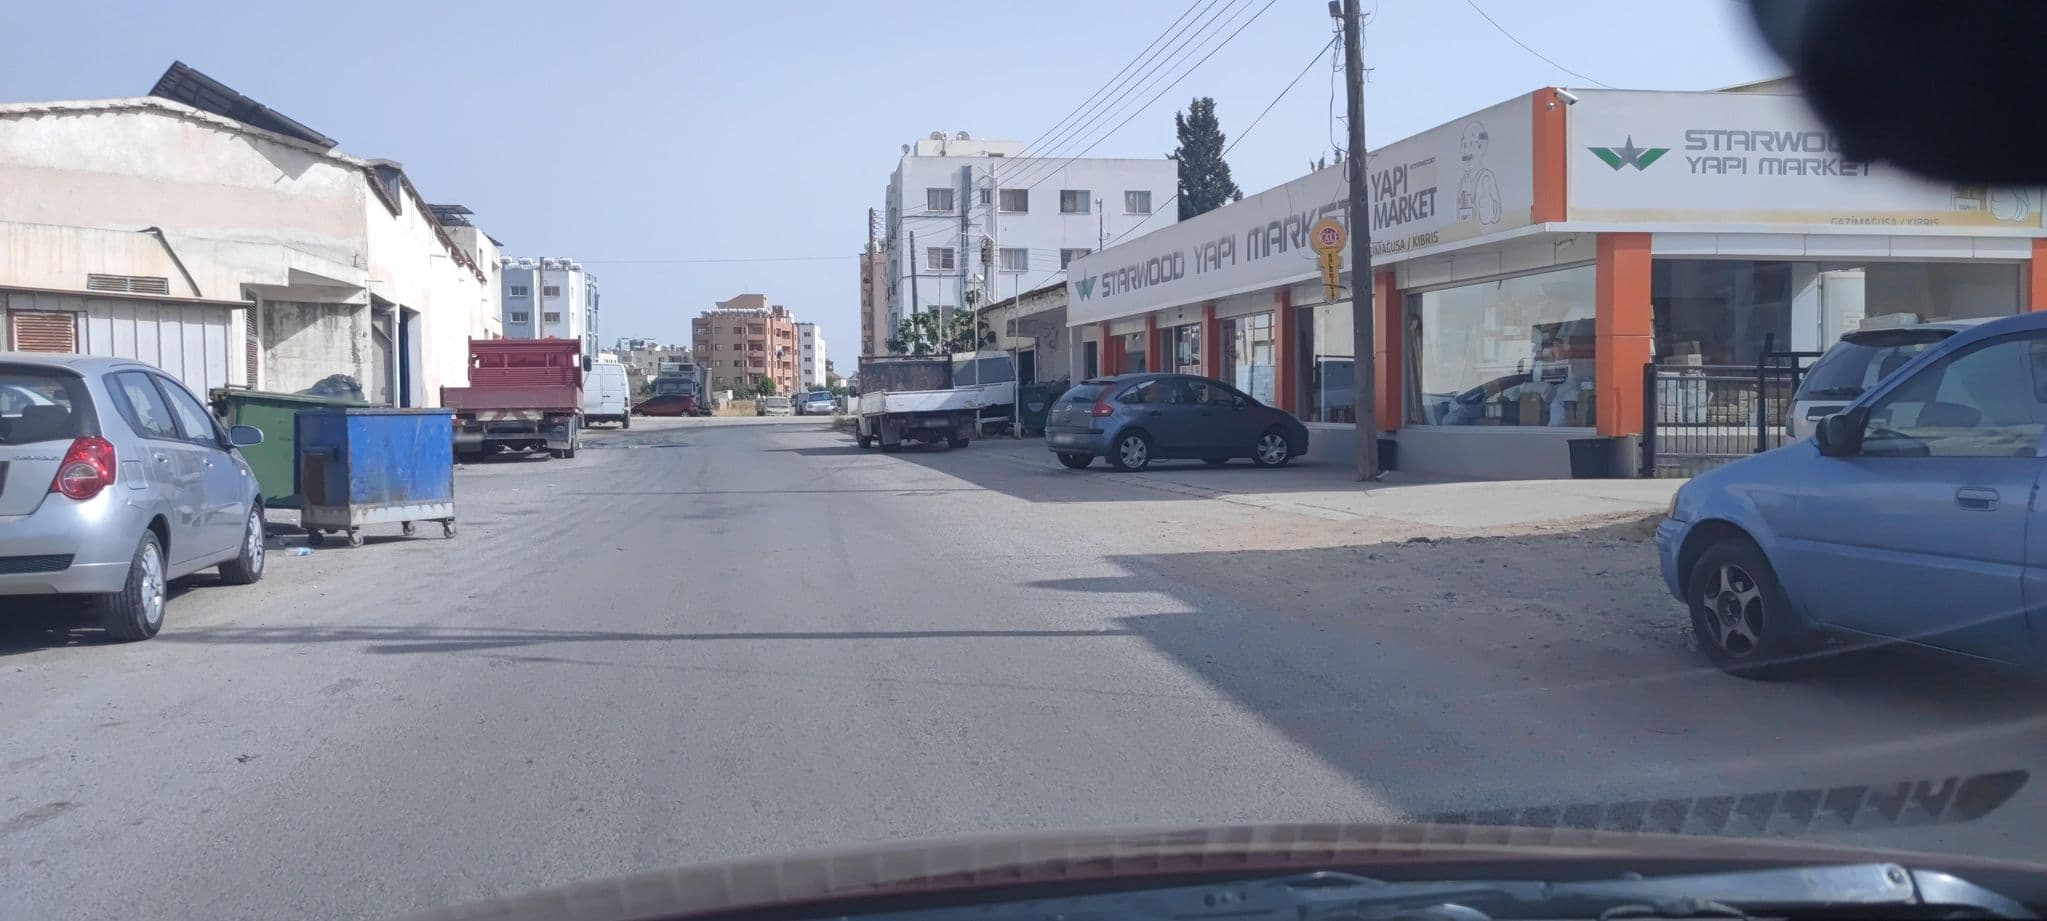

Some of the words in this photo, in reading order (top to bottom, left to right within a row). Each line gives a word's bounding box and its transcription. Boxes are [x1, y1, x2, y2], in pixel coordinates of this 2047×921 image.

[1684, 129, 1841, 152] STARWO
[1685, 155, 1748, 175] YAPI
[1757, 157, 1870, 177] MARKET
[1370, 163, 1408, 203] YAPI
[1372, 186, 1438, 231] MARKET
[1412, 231, 1439, 249] KIBRIS
[1101, 249, 1185, 298] STARWOOD
[1194, 232, 1236, 275] YAPI
